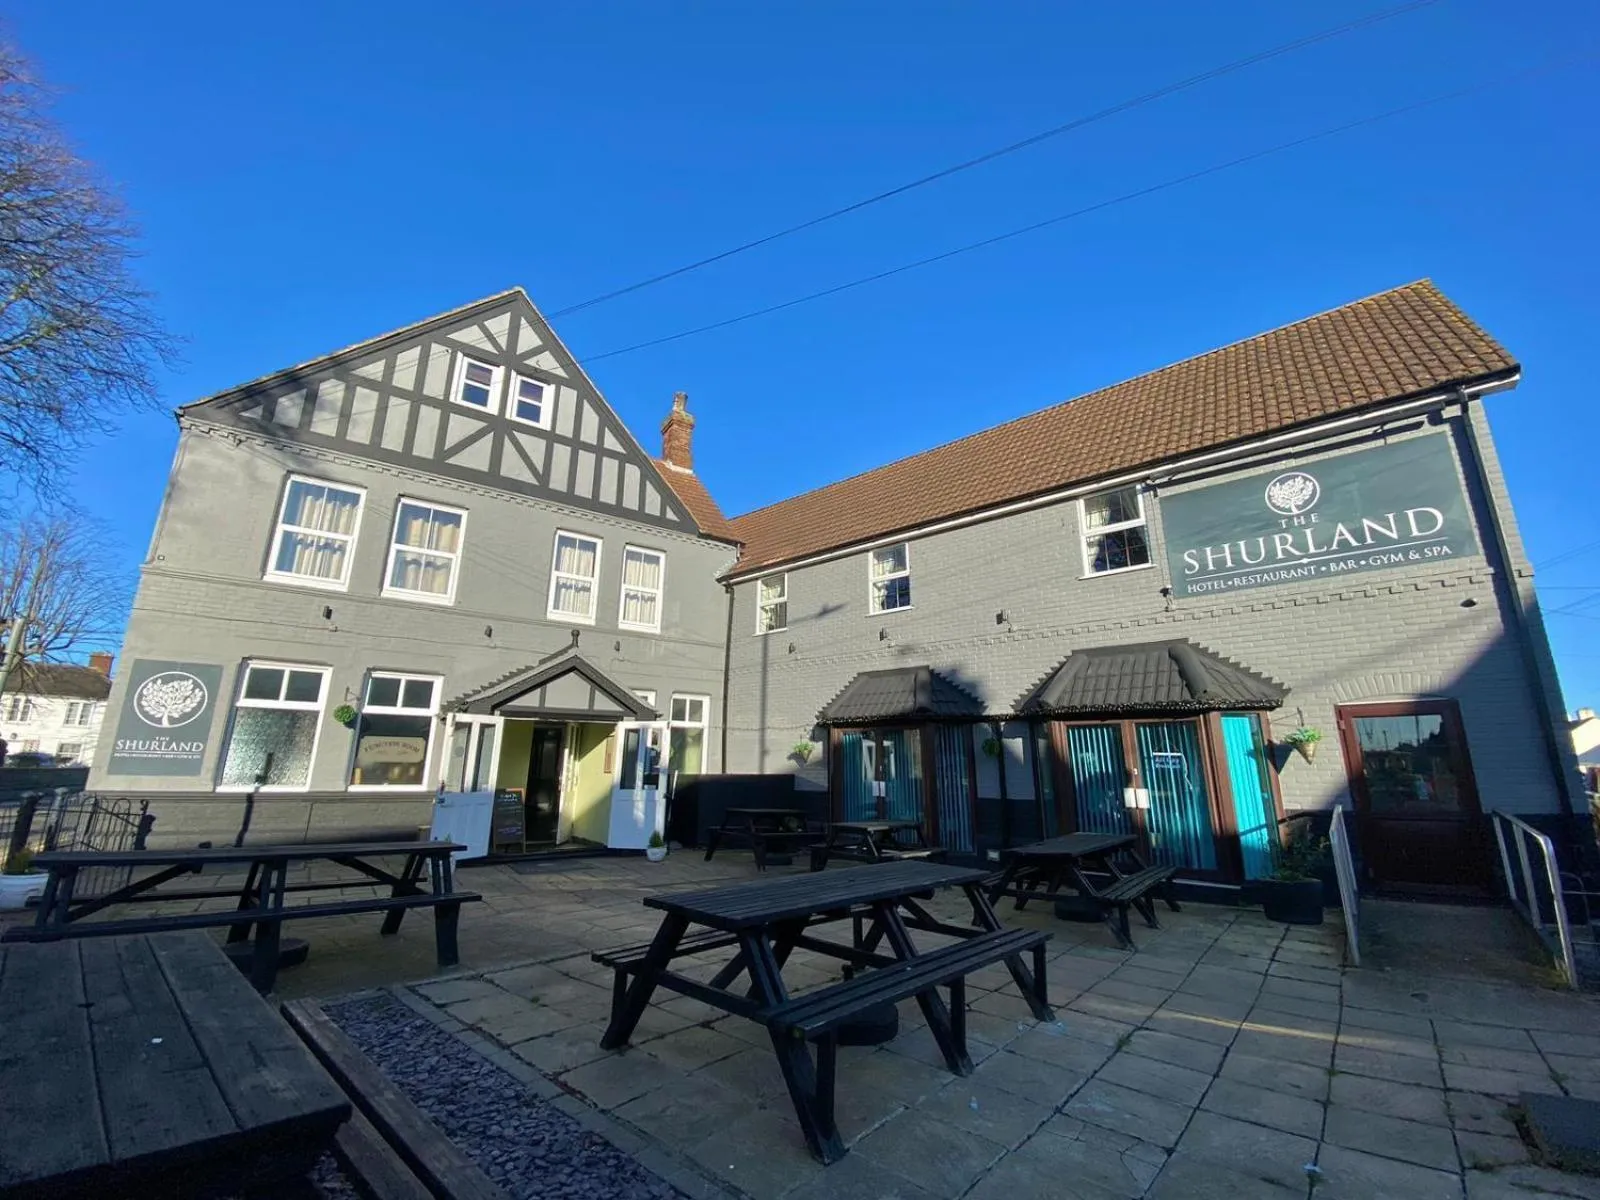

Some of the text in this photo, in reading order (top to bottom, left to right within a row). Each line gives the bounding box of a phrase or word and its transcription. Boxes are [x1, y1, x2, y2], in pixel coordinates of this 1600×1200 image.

[1279, 512, 1320, 529] THE
[1183, 506, 1444, 575] SHURLAND
[1329, 560, 1357, 573] BAR
[1369, 552, 1405, 567] GYM
[1408, 549, 1422, 560] &
[1424, 545, 1453, 558] SPA
[115, 739, 204, 752] SHURLAND
